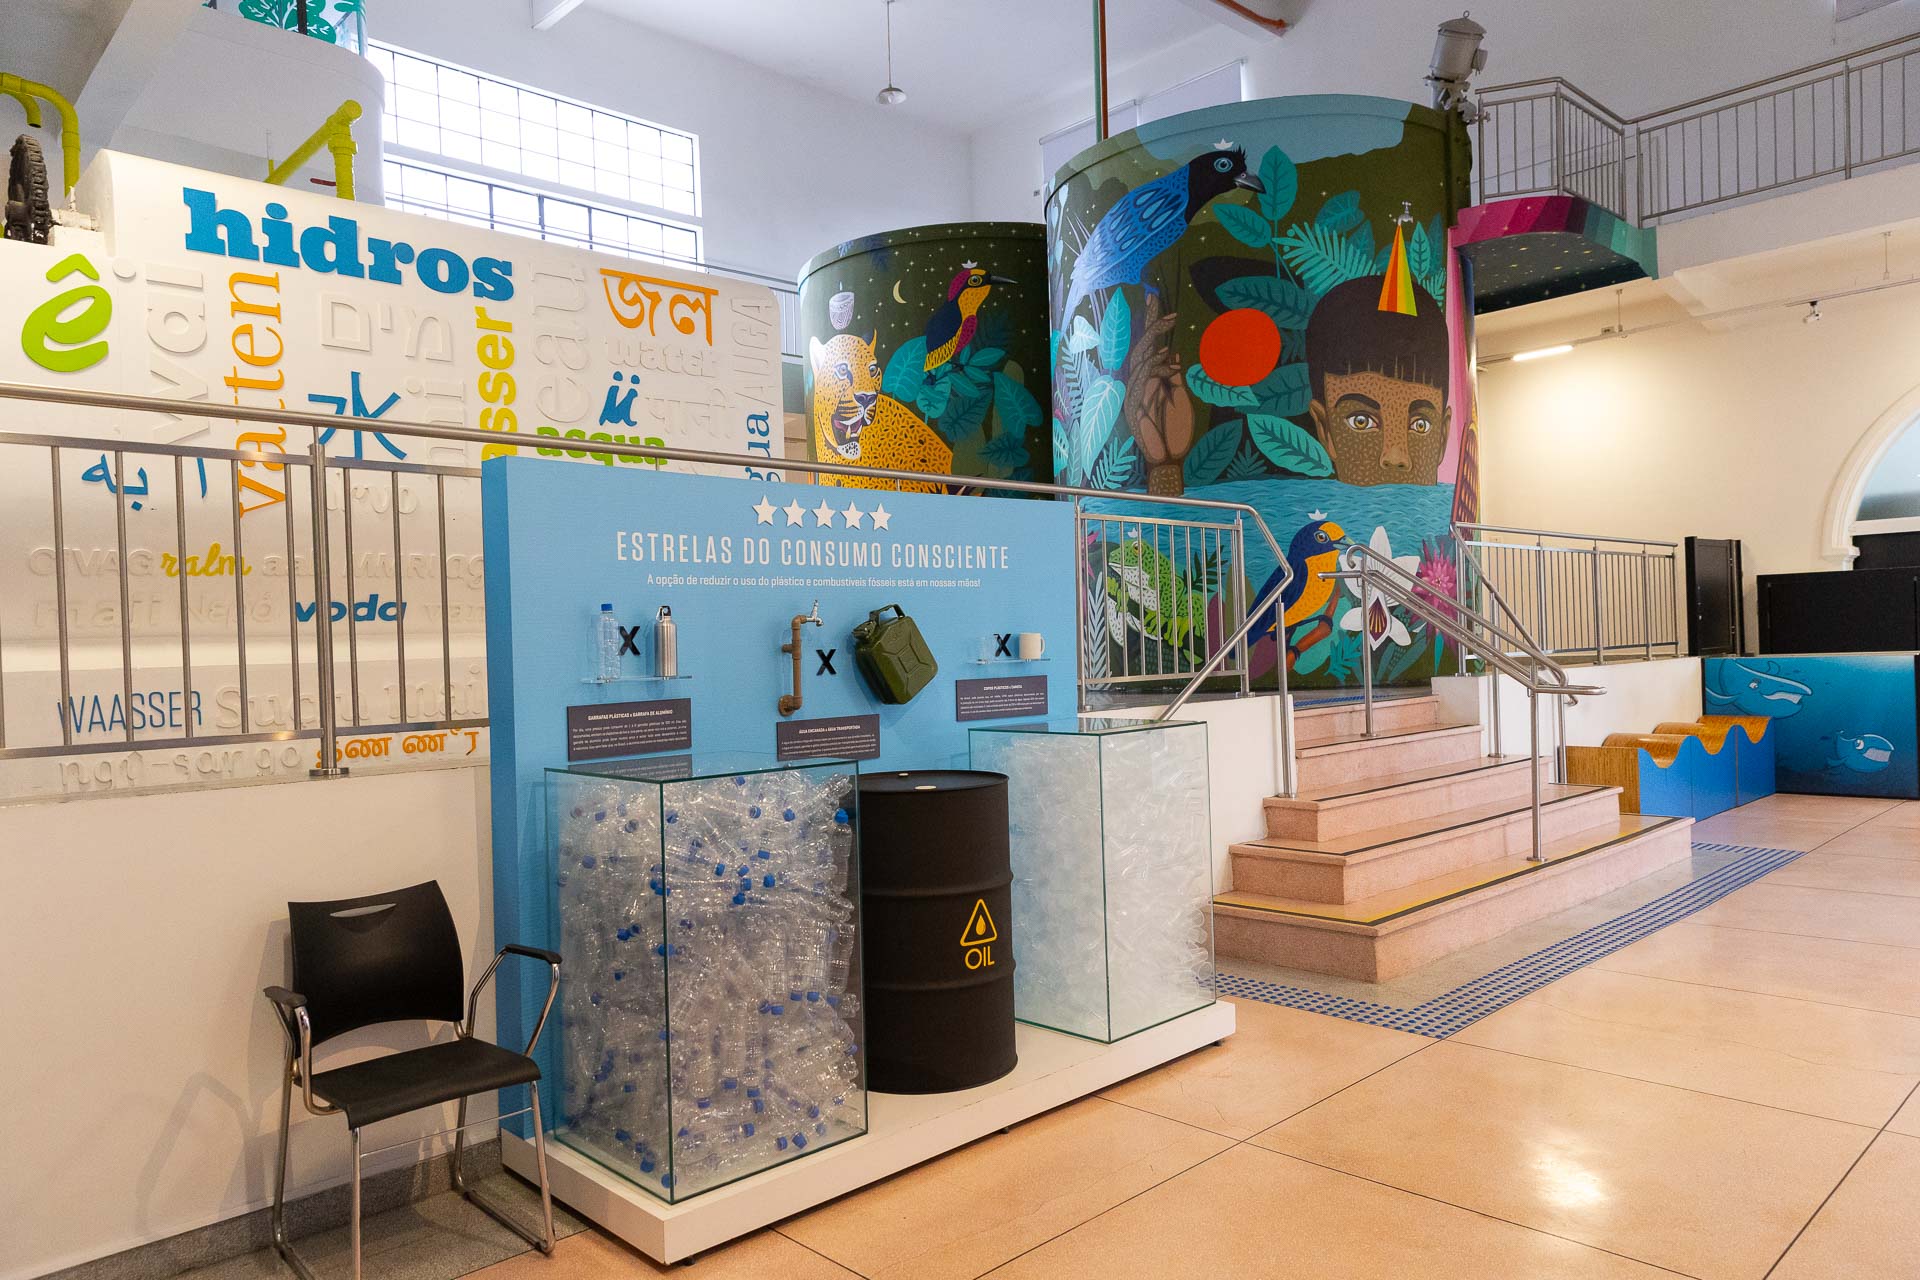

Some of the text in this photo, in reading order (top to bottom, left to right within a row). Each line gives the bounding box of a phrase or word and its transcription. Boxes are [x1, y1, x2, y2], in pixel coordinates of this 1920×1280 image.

[183, 187, 514, 302] hidros
[21, 253, 113, 373] ê
[599, 267, 720, 347] জল
[224, 272, 287, 518] vaten
[308, 371, 407, 461] 水
[536, 426, 668, 466] acqua
[745, 410, 781, 482] gua
[616, 531, 1009, 569] ESTRELAS DO CONSUMO CONSCIENTE
[295, 593, 407, 623] voda
[647, 574, 654, 585] A
[656, 574, 684, 588] opção
[686, 575, 698, 586] de
[700, 575, 731, 586] reduzir
[733, 578, 739, 586] o
[741, 578, 756, 586] uso
[758, 576, 770, 587] do
[771, 575, 805, 588] plástico
[806, 579, 812, 587] e
[868, 577, 896, 588] fósseis
[897, 577, 914, 588] está
[916, 580, 929, 588] em
[930, 579, 957, 588] nossas
[957, 577, 981, 588] mãos!
[57, 690, 203, 734] WAASSER
[965, 947, 995, 971] OIL
